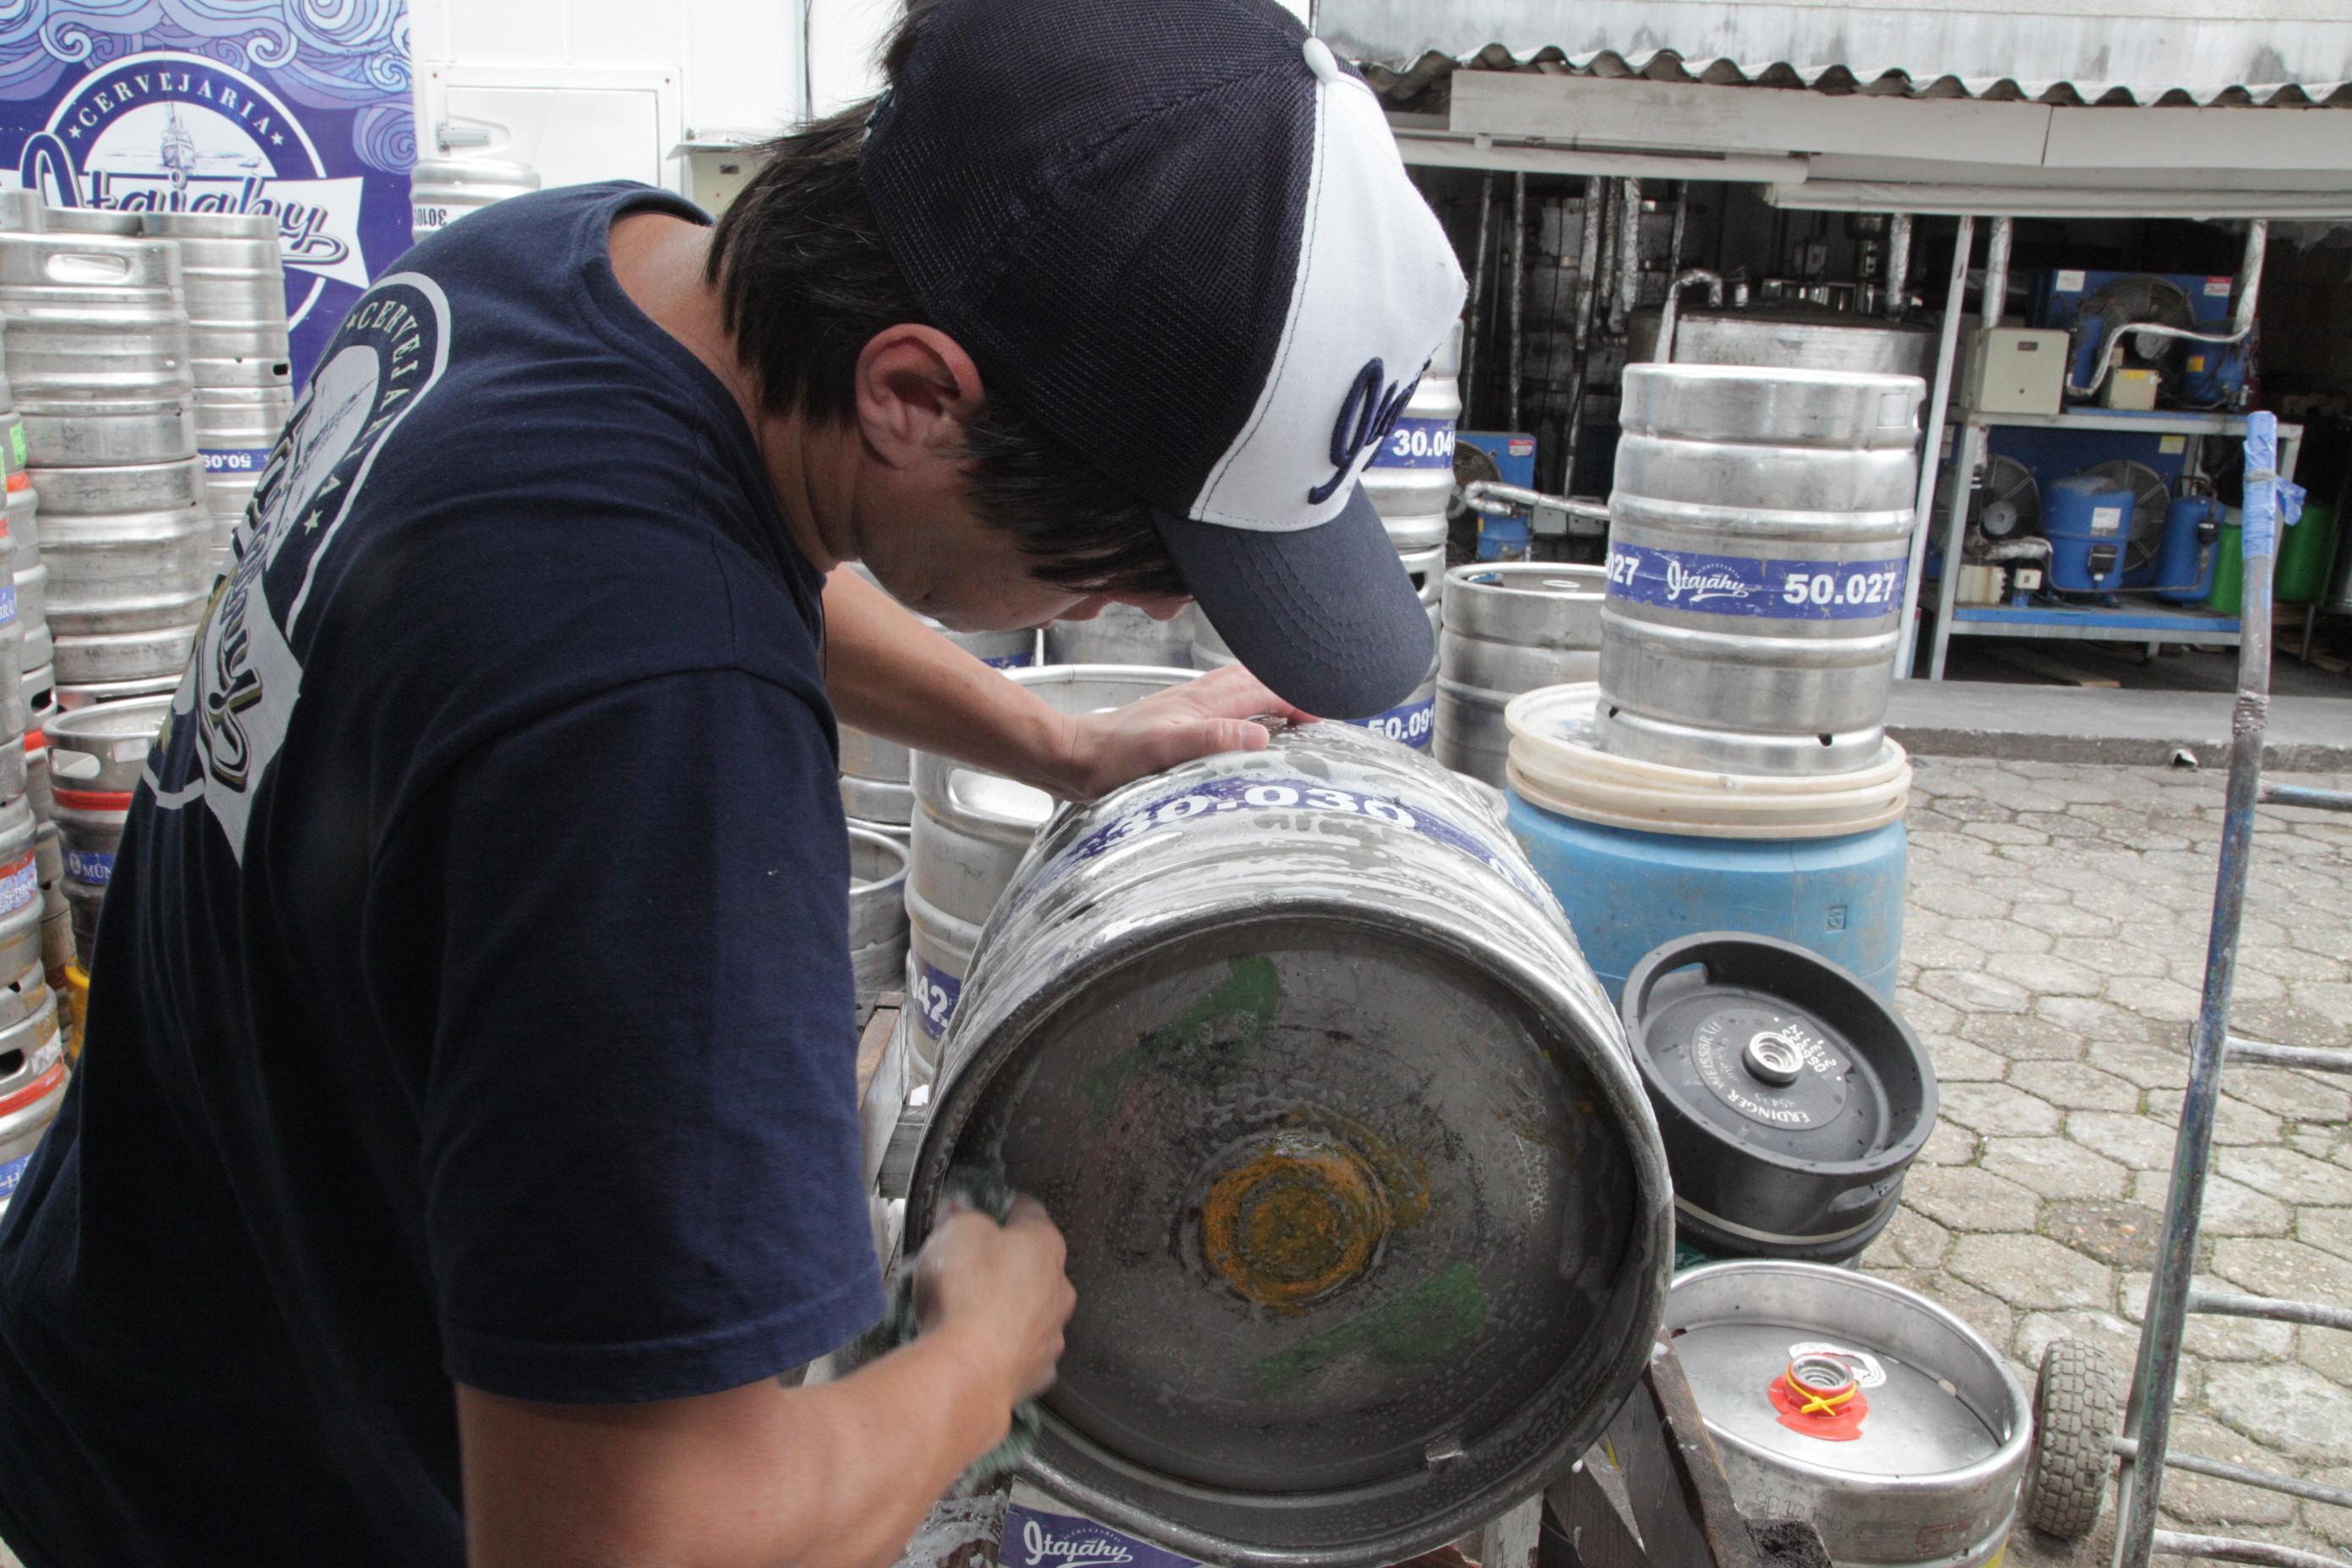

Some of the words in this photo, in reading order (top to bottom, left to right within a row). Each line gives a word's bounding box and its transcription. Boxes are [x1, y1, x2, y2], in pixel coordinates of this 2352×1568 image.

[78, 72, 272, 136] CERVEJARIA
[1783, 572, 1897, 605] 50.027
[1727, 1087, 1811, 1124] ERDINGER
